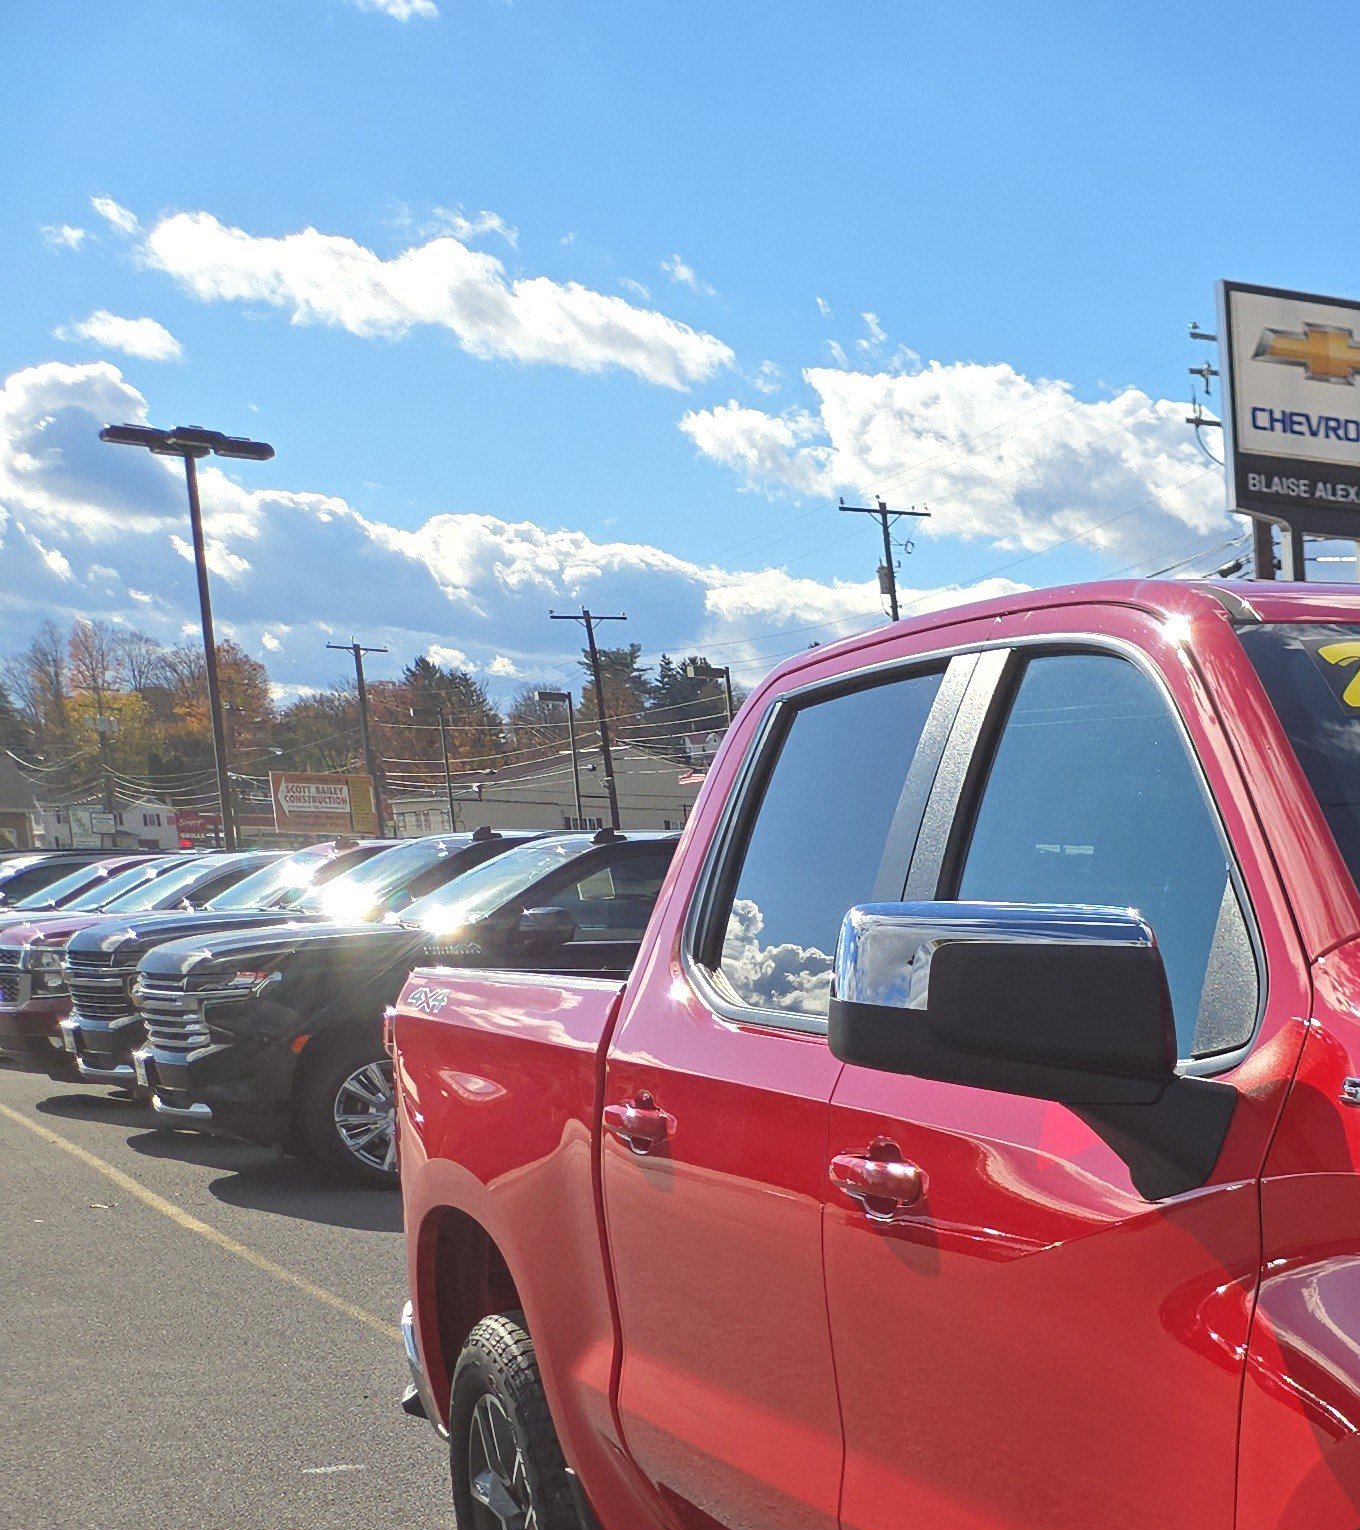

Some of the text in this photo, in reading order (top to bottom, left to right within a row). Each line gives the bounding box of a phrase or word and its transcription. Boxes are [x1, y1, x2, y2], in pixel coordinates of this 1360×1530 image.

[1247, 473, 1311, 500] BLAISE
[285, 784, 312, 795] SCOTT
[284, 794, 347, 806] CONSTRUCTION
